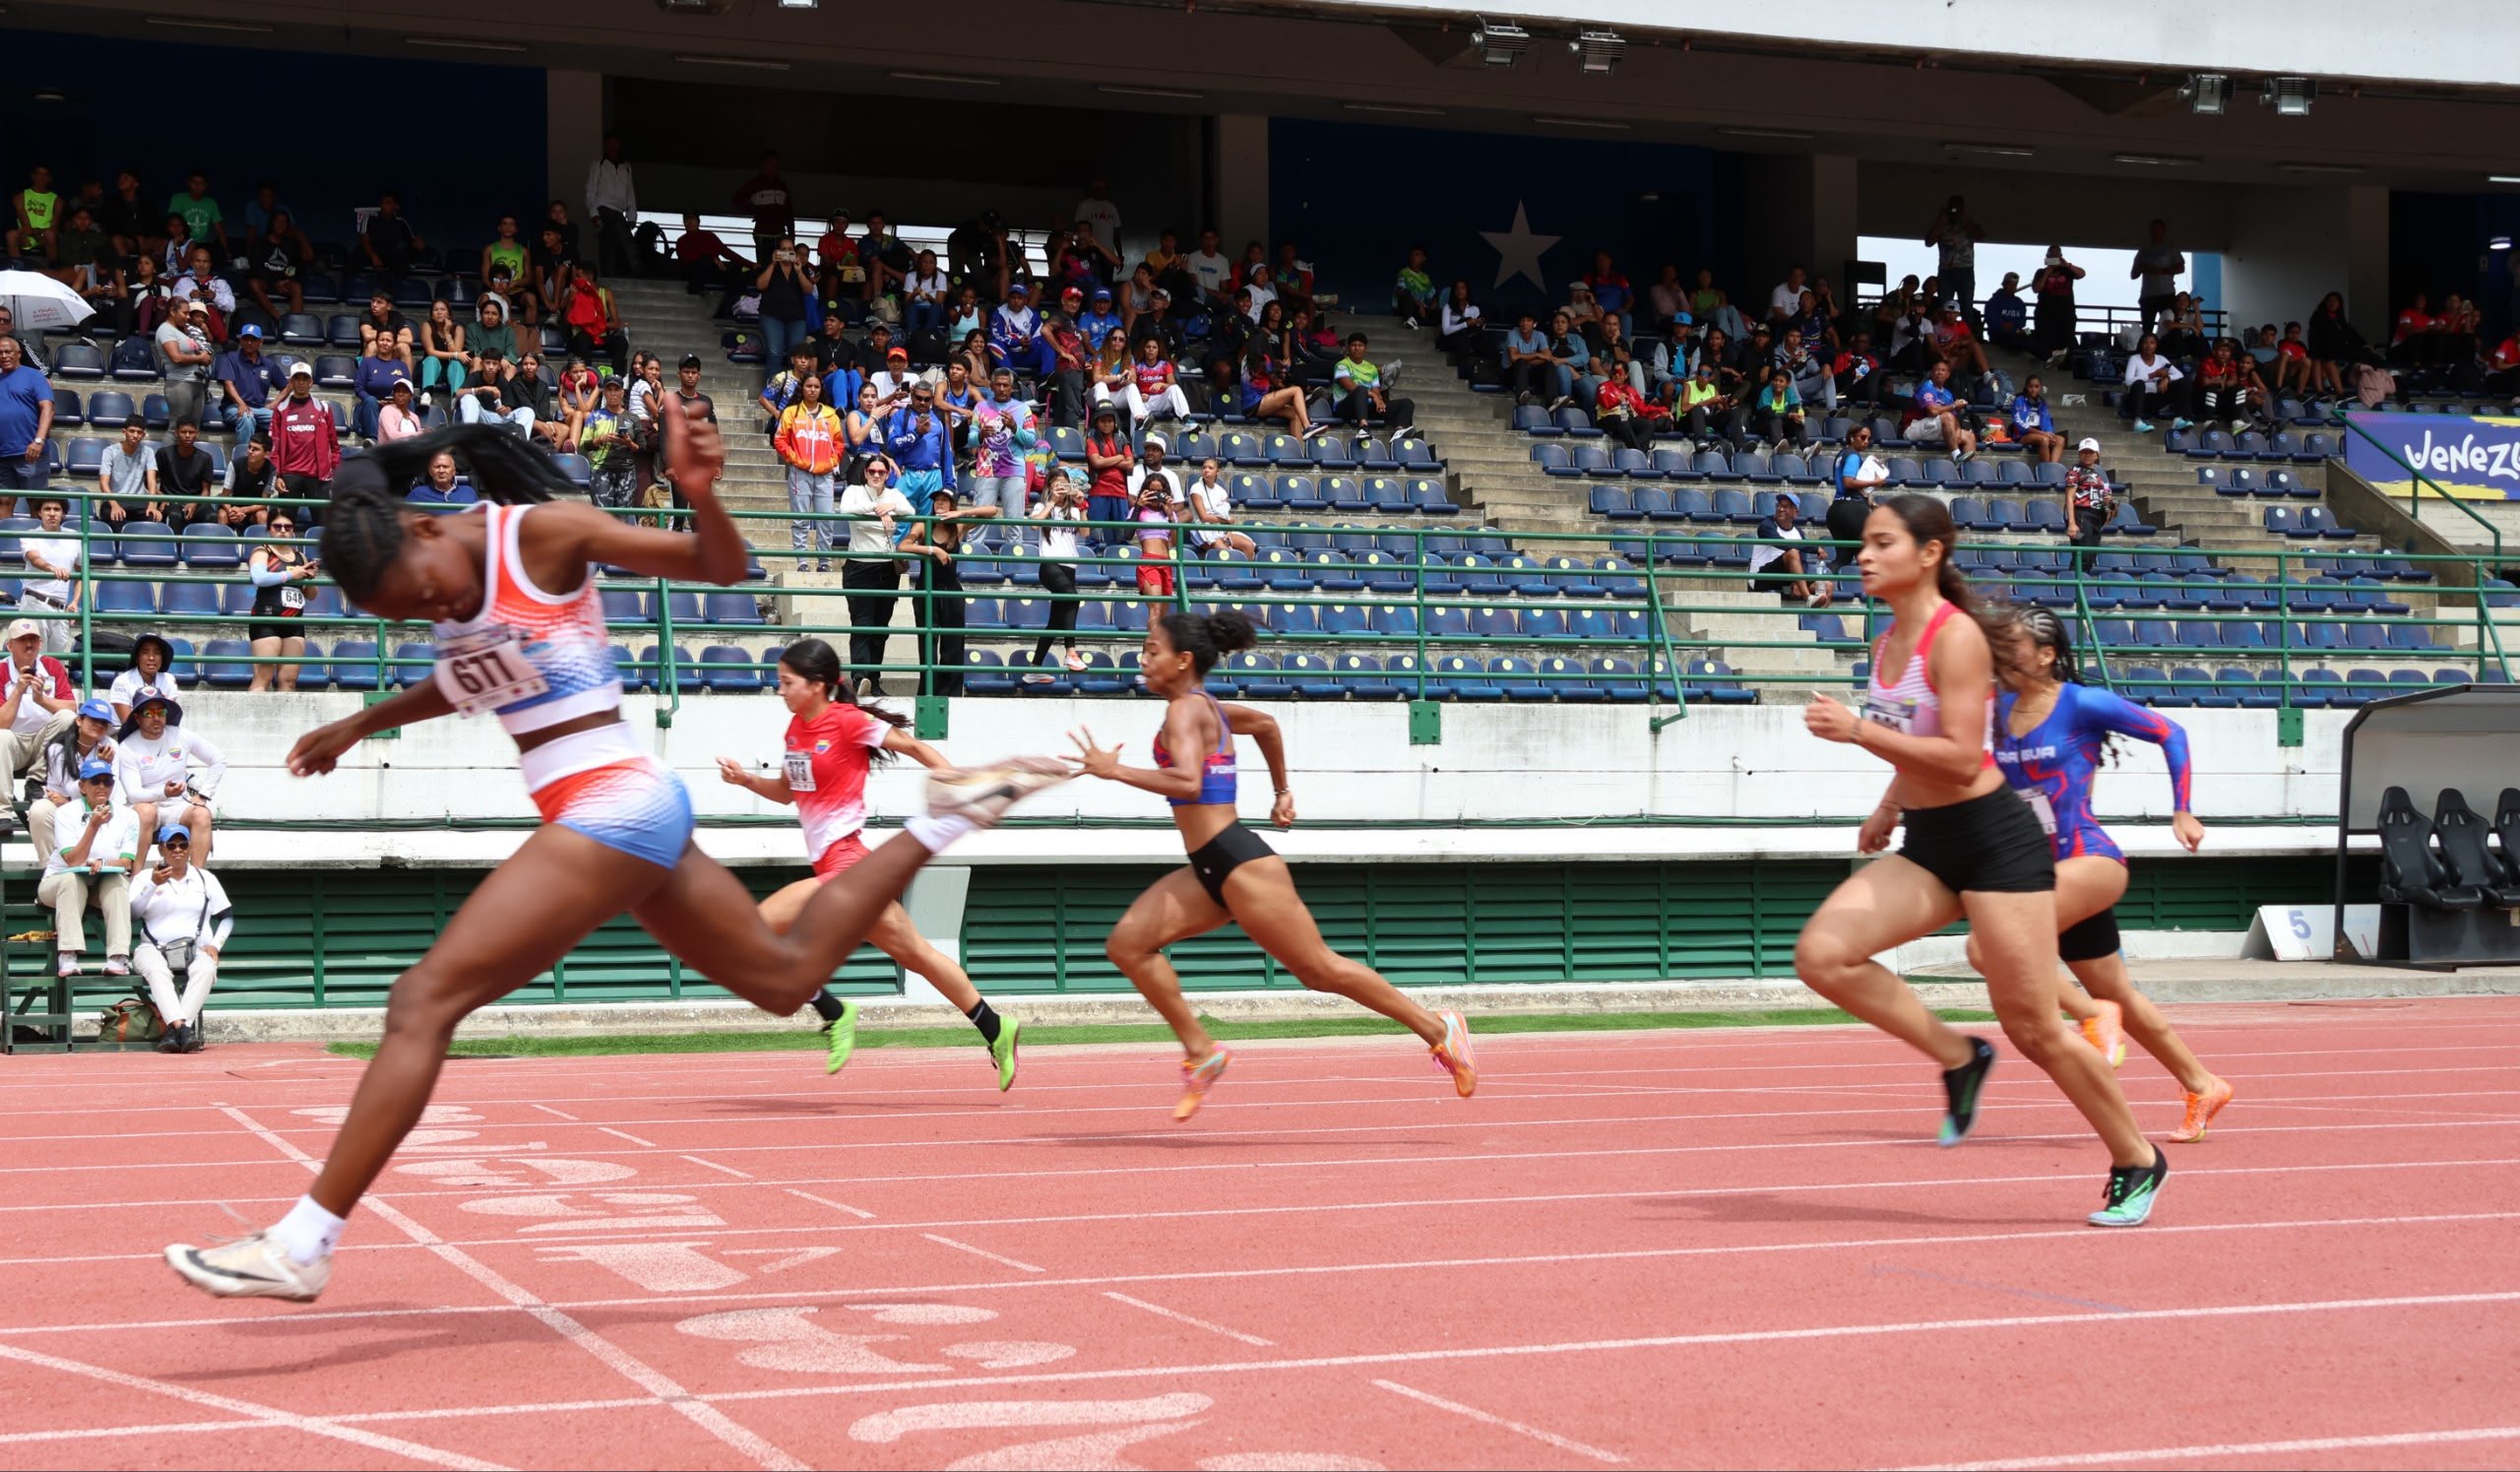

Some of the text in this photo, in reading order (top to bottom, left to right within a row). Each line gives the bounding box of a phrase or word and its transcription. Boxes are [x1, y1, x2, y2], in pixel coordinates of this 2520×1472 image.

[285, 591, 303, 605] 648
[450, 650, 516, 695] 677
[2287, 910, 2312, 940] 5
